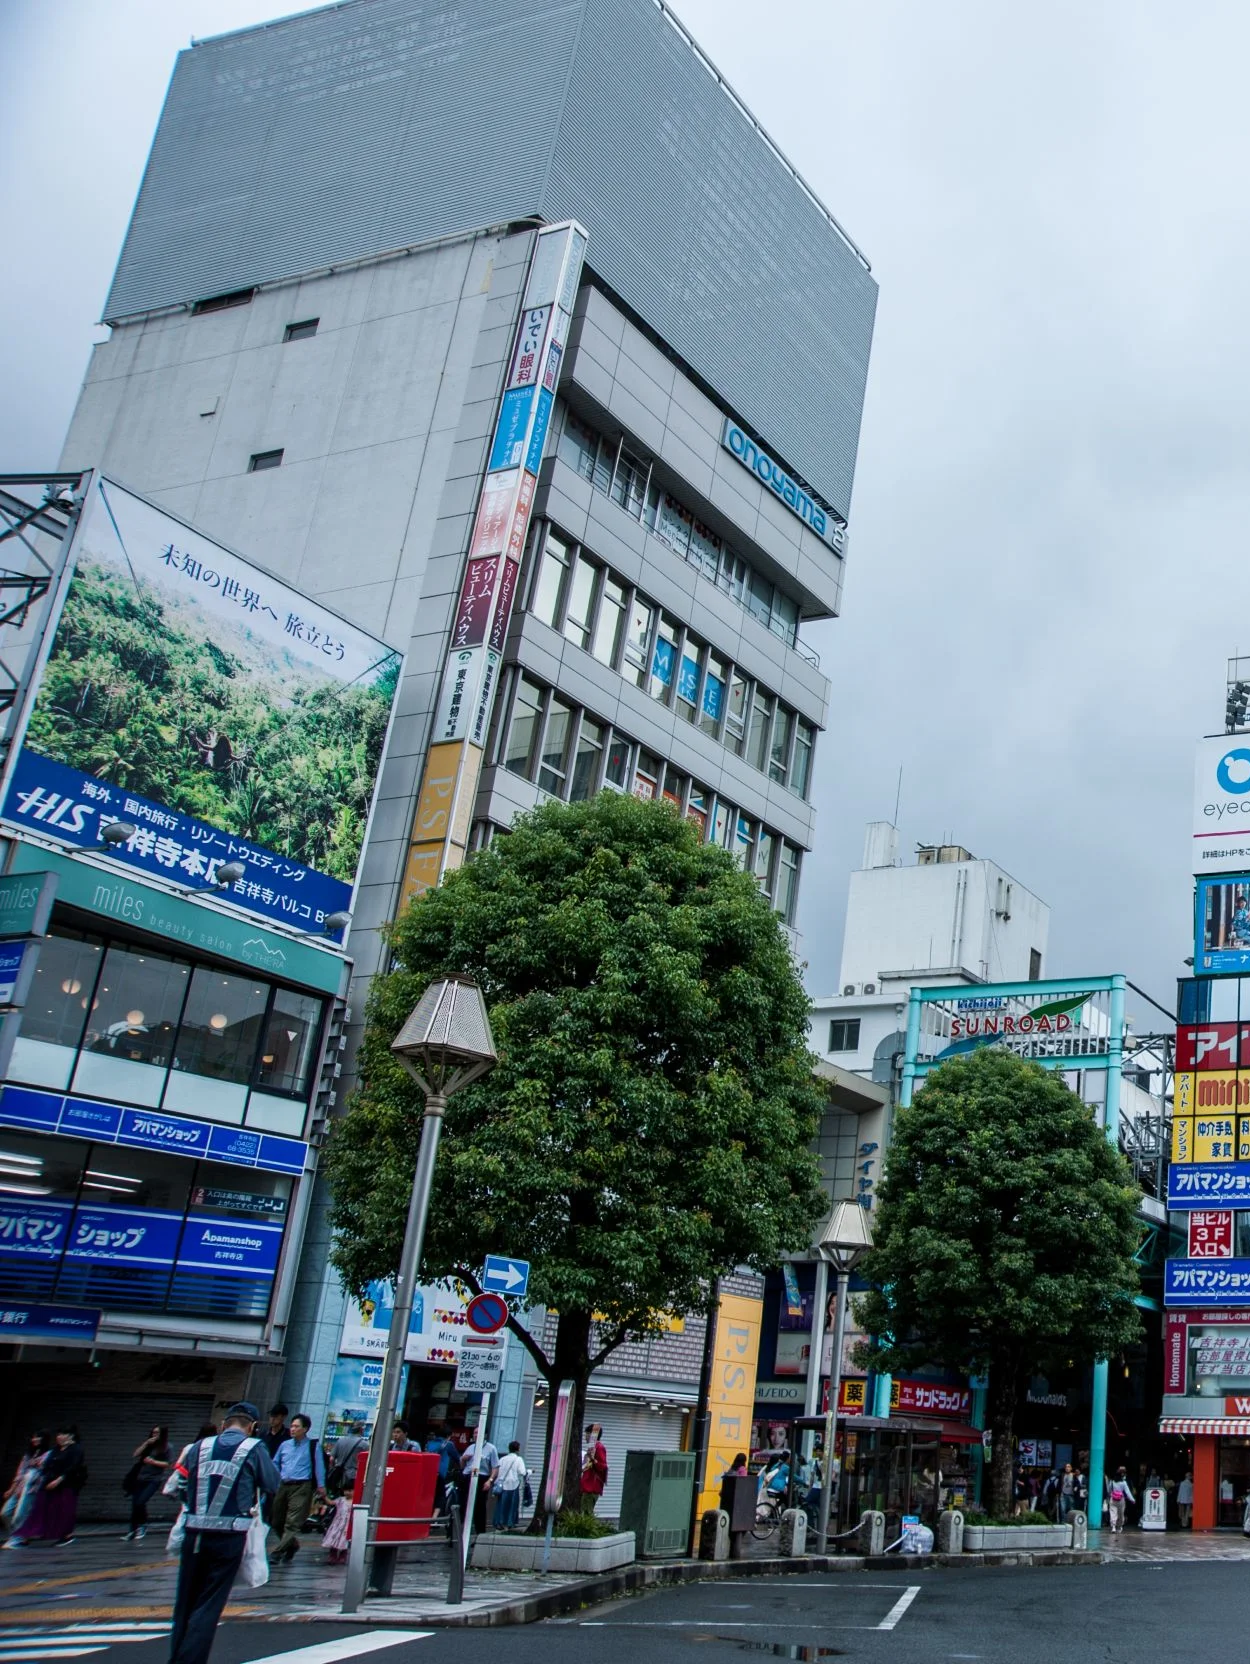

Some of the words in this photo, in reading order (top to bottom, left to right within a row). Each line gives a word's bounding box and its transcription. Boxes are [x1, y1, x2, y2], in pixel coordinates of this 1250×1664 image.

[517, 310, 543, 384] いでい眼科
[501, 400, 522, 466] ミュゼプラチナム
[729, 428, 827, 536] onoyama
[478, 557, 497, 598] スリム
[157, 542, 279, 622] 未知の世界へ
[283, 612, 347, 661] 旅立とう
[455, 563, 484, 646] ビューティハウス
[491, 562, 514, 647] スリムビューティハウス
[450, 668, 468, 718] 東京建物
[93, 884, 145, 921] miles
[150, 913, 194, 940] beauty
[200, 932, 233, 952] salon
[233, 879, 312, 920] 吉祥寺パルコ
[315, 909, 329, 924] B
[951, 1013, 1071, 1037] SUNROAD
[1198, 1079, 1250, 1107] mini
[132, 1118, 201, 1143] アパマンショップ
[856, 1141, 878, 1210] ダイヤ街
[202, 1229, 263, 1248] Apamanshop
[1192, 1212, 1230, 1226] 当ビル
[214, 1250, 244, 1262] 吉祥寺店
[1191, 1242, 1218, 1256] 入口
[438, 1331, 458, 1343] Miru
[1169, 1332, 1181, 1387] Homemate
[755, 1388, 798, 1398] HISEIDO
[847, 1384, 863, 1403] 薬
[915, 1387, 961, 1411] サンドラッグ
